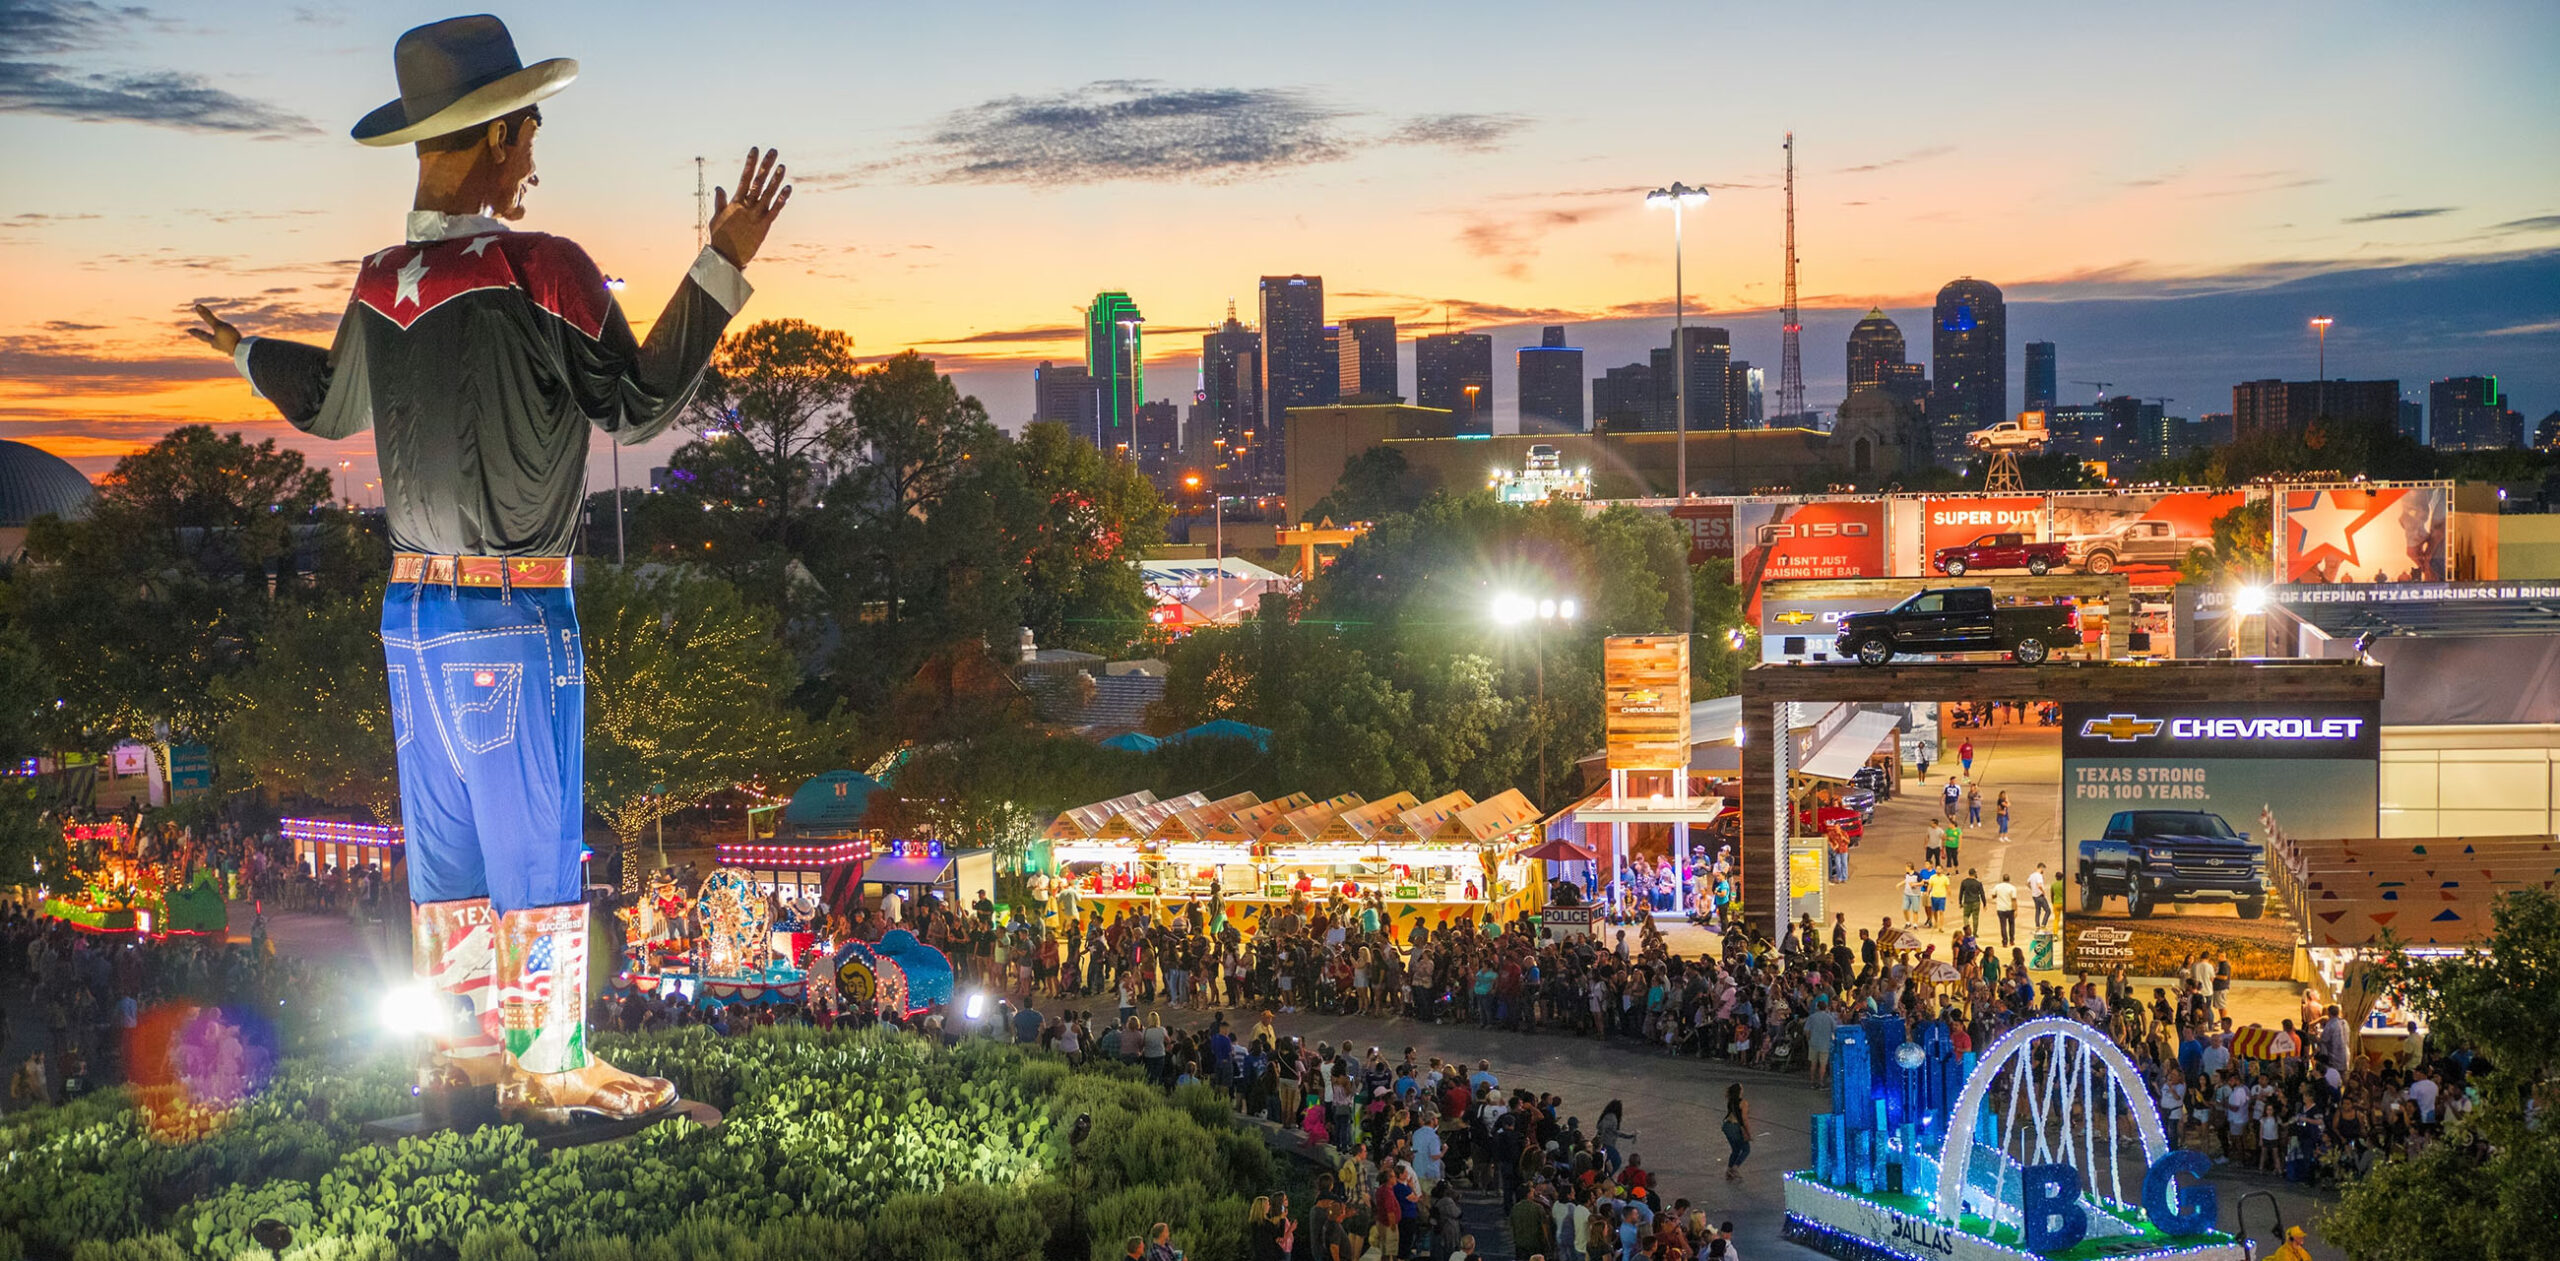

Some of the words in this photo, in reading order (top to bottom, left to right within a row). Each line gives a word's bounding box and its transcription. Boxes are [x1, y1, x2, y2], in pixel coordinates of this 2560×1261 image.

[1933, 511, 1992, 525] SUPER
[1997, 510, 2042, 525] DUTY
[395, 557, 423, 579] BIG
[1777, 556, 1788, 566] IT
[1790, 555, 1818, 566] ISN'T
[1821, 555, 1847, 565] JUST
[1764, 567, 1810, 577] RAISING
[1813, 567, 1833, 576] THE
[1837, 566, 1860, 576] BAR
[2302, 590, 2367, 603] KEEPING
[2500, 587, 2518, 598] IN
[2170, 718, 2364, 739] CHEVROLET
[2076, 767, 2133, 783] TEXAS
[2137, 767, 2206, 783] STRONG
[2076, 784, 2110, 799] FOR
[2114, 784, 2143, 799] 100
[2149, 784, 2211, 800] YEARS.
[1544, 910, 1588, 922] POLICE
[2077, 946, 2134, 956] TRUCKS
[2021, 1163, 2088, 1252] B
[2141, 1149, 2218, 1236] G
